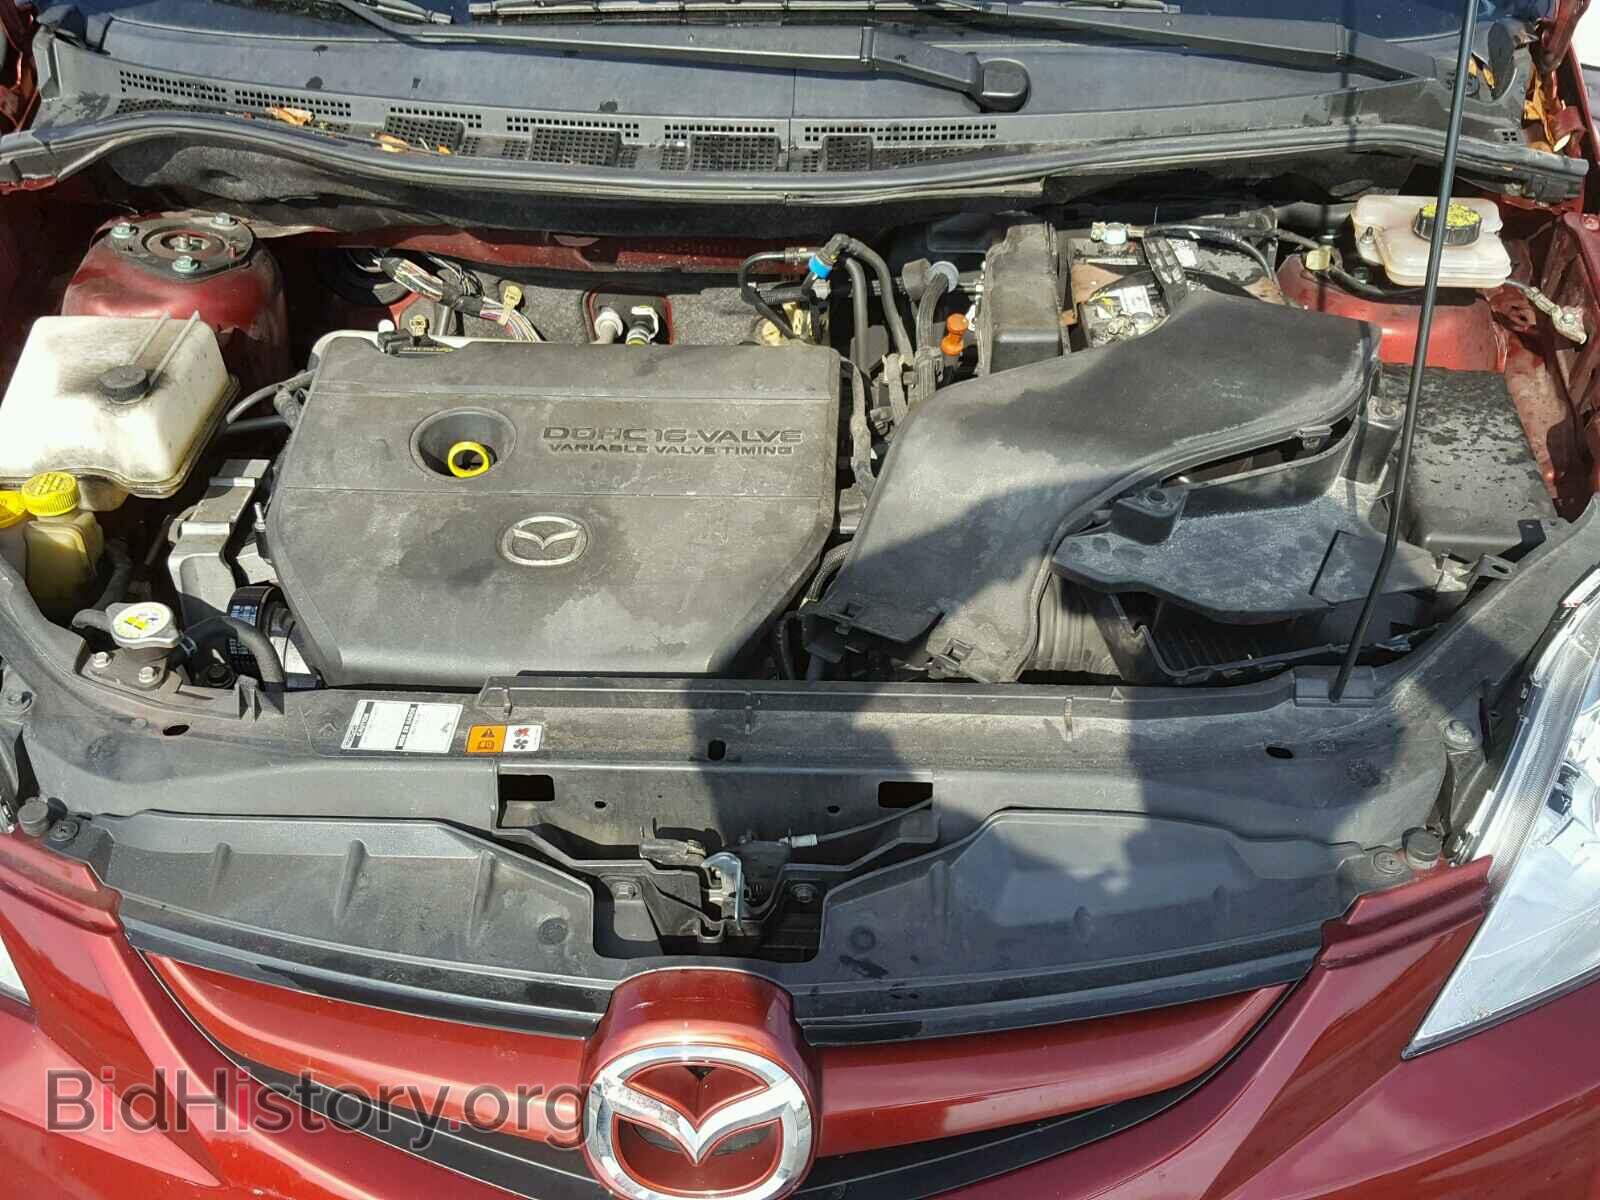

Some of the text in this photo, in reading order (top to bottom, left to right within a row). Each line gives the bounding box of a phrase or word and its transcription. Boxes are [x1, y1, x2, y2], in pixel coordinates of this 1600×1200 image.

[543, 426, 803, 443] DOHC 16-VALVE
[549, 443, 793, 456] VARIABLE VALVE TIMING
